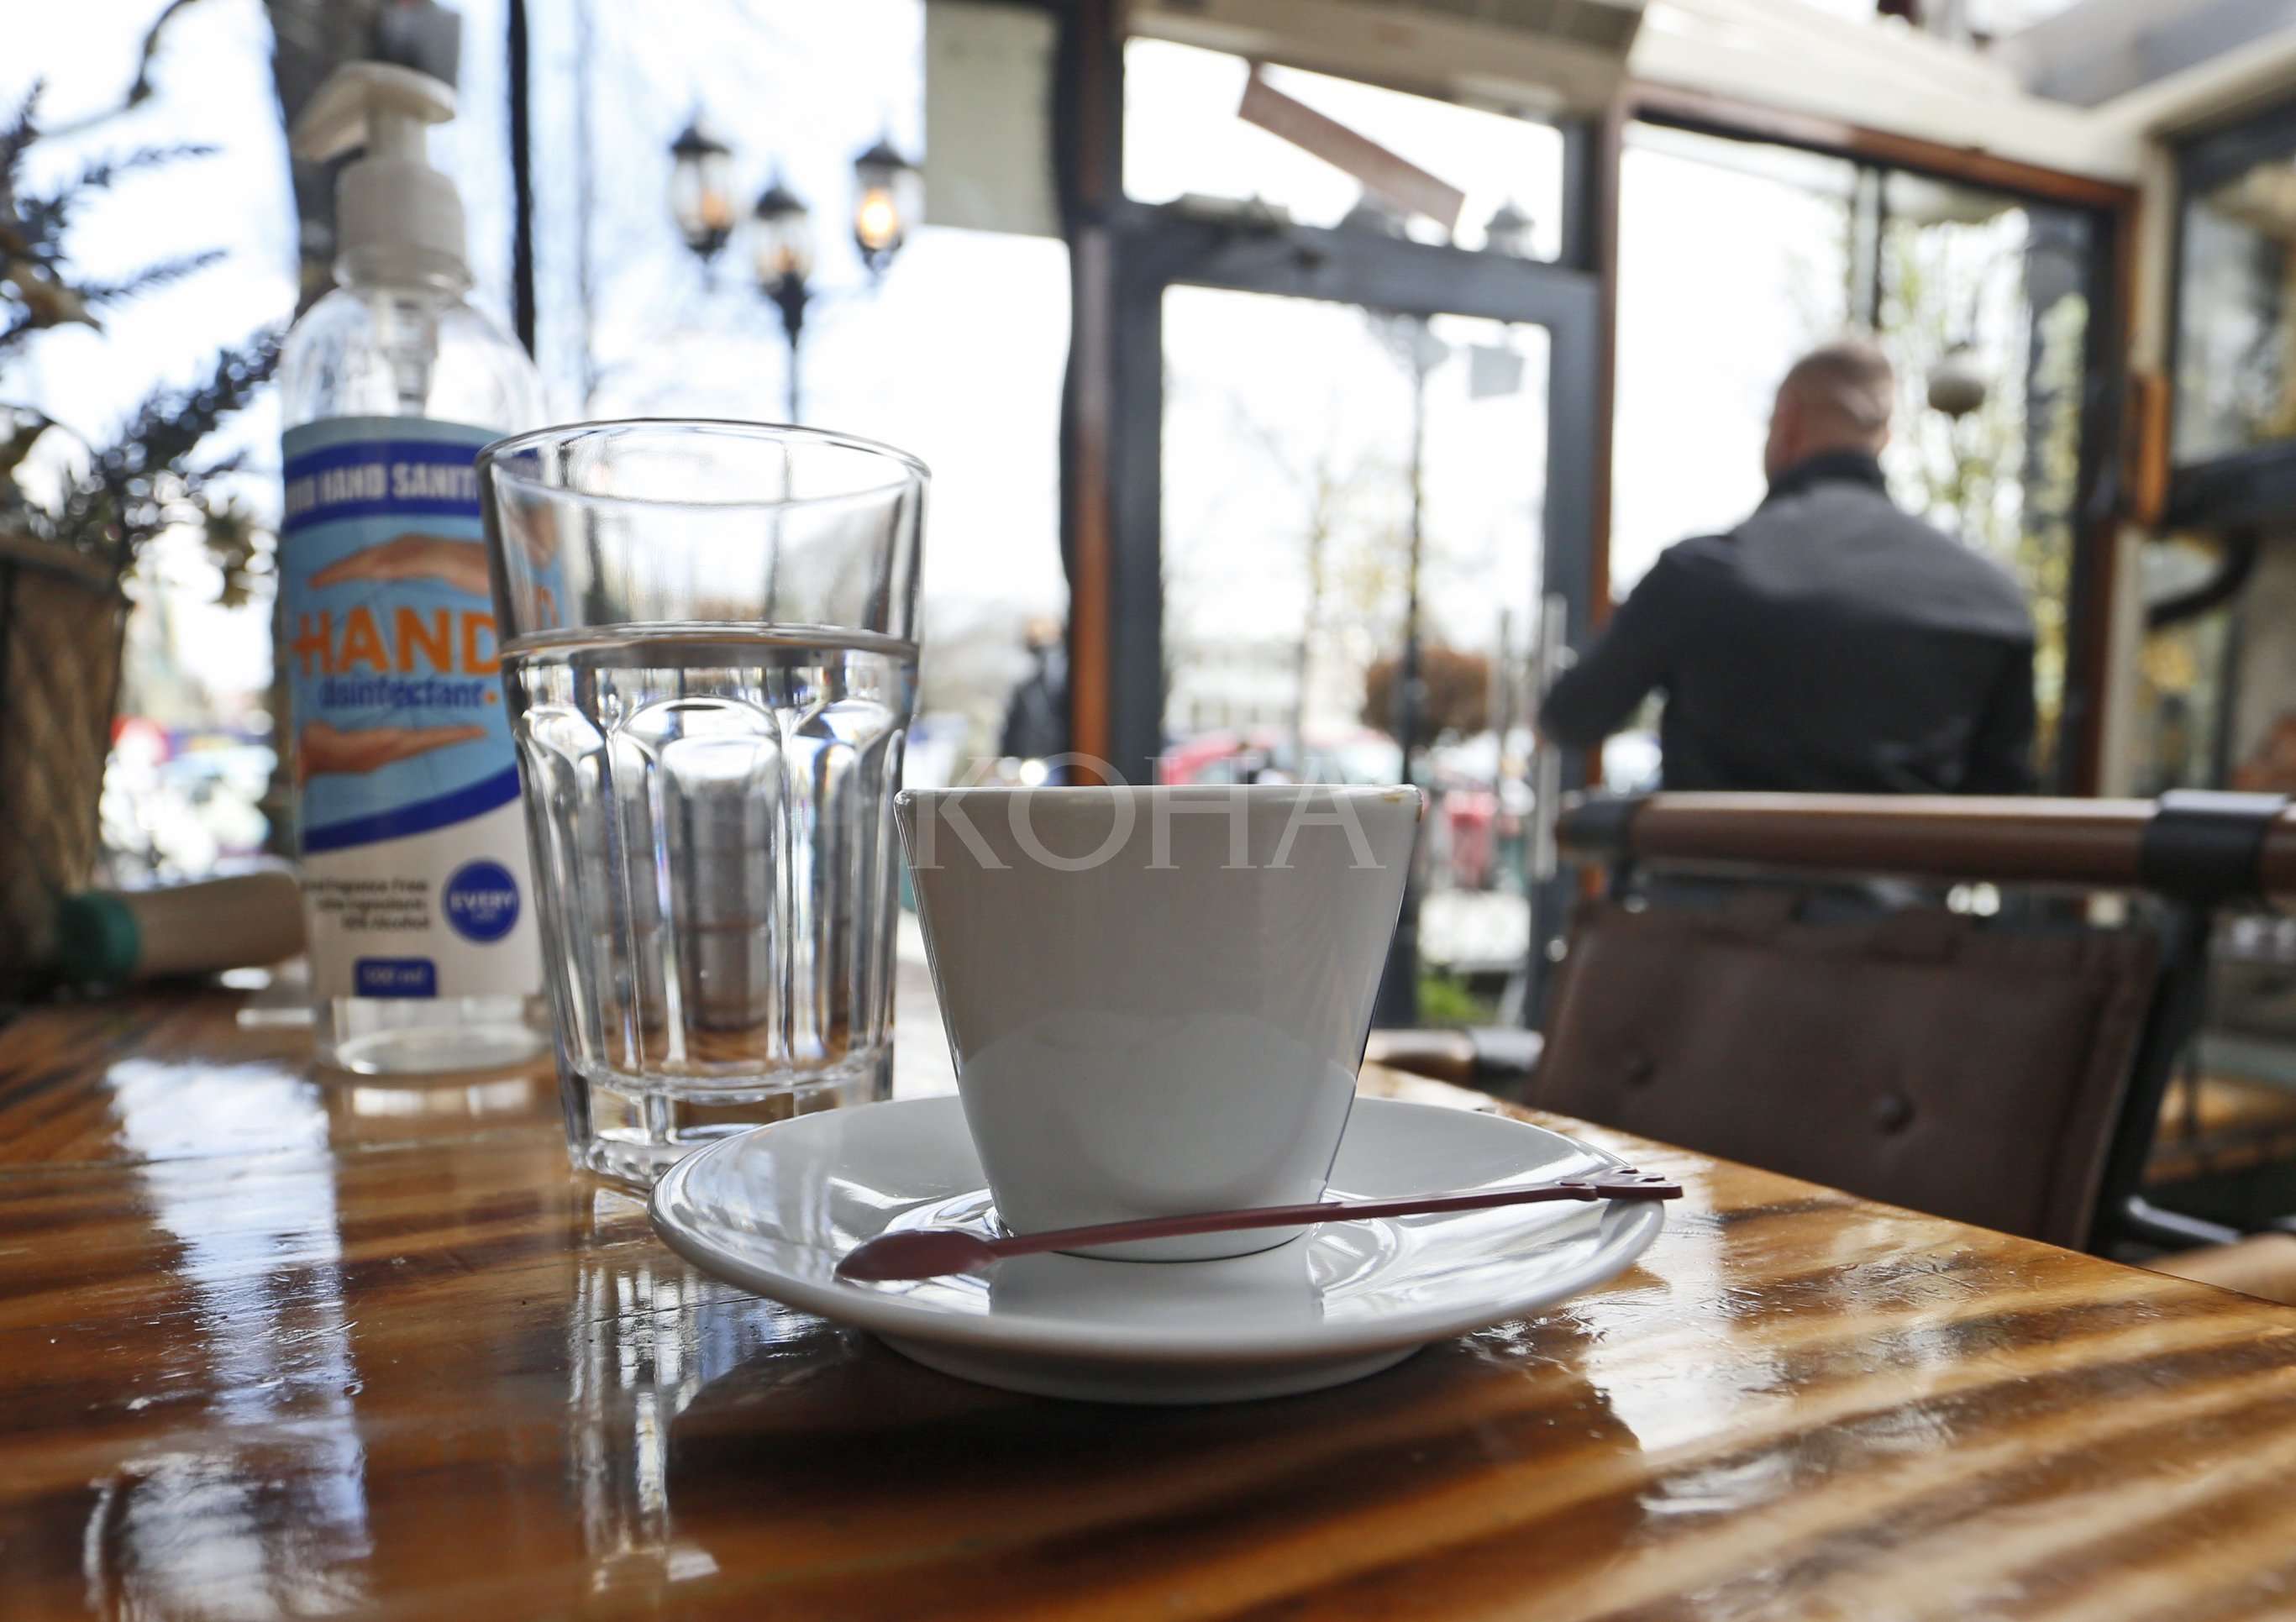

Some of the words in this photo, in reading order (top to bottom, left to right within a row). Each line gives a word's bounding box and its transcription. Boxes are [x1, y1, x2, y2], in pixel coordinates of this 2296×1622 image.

[321, 465, 386, 504] HAND
[391, 463, 478, 500] SANIT
[291, 605, 502, 677] HAND
